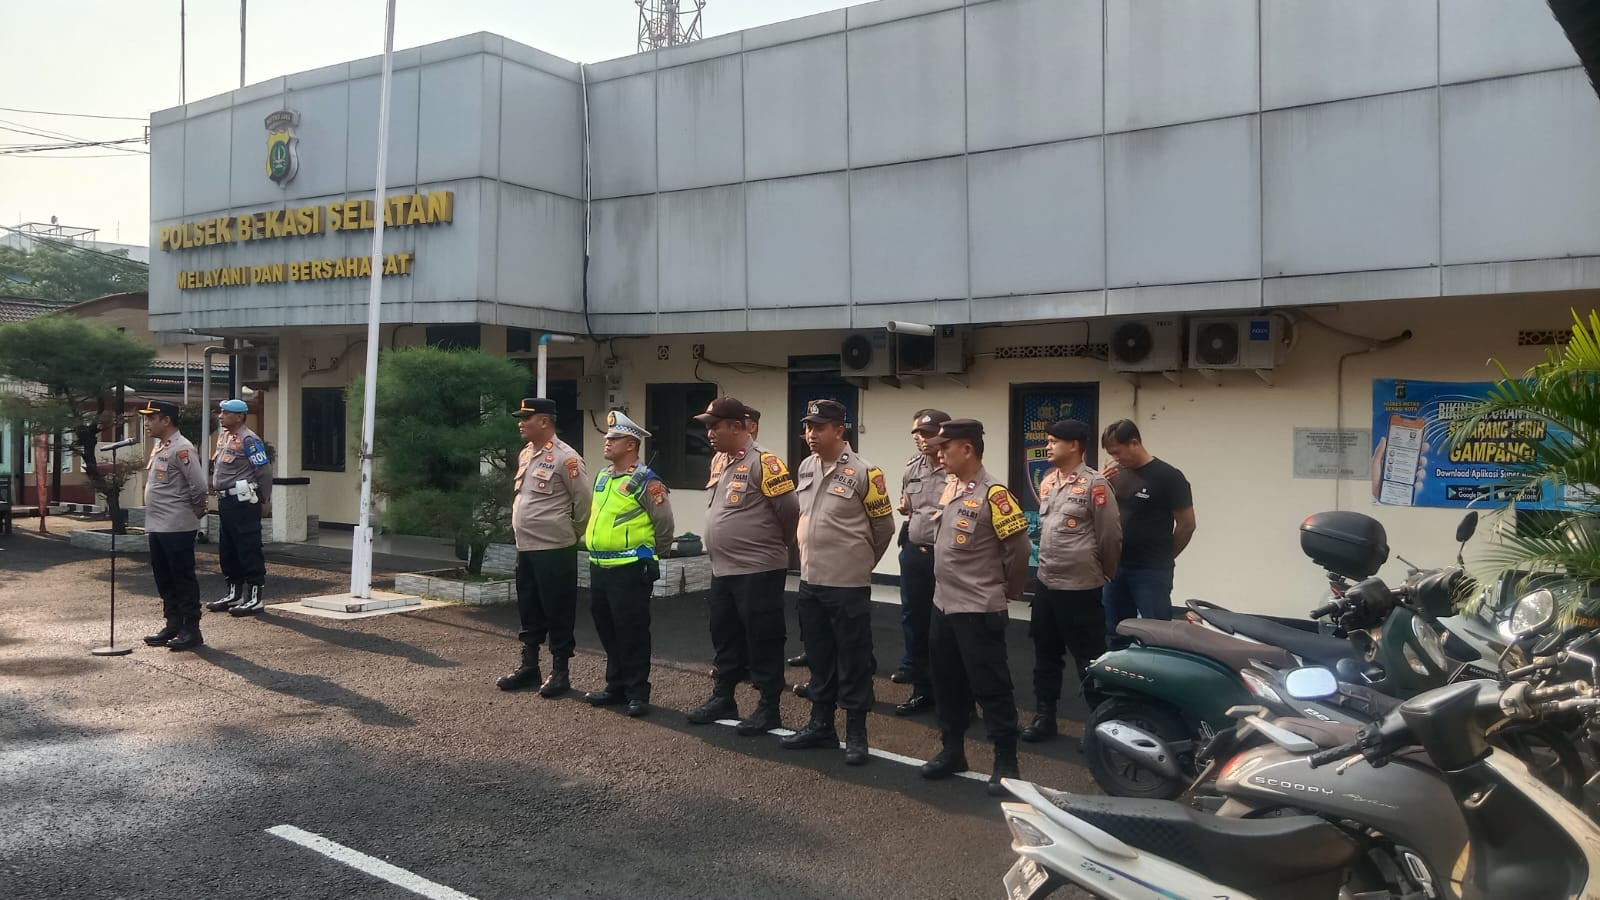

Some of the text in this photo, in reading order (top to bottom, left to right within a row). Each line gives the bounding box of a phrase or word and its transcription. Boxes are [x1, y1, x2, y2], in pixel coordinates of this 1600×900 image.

[160, 191, 451, 251] POLSEK BEKASI SELATAN
[177, 253, 411, 289] MELAYANI DAN BERSAHAAT
[833, 473, 856, 487] POLRI
[1436, 468, 1470, 478] Download
[1471, 469, 1499, 480] Aplikasi
[1458, 491, 1477, 500] Google
[957, 508, 978, 519] POLRI
[1255, 776, 1334, 795] SCOOPY
